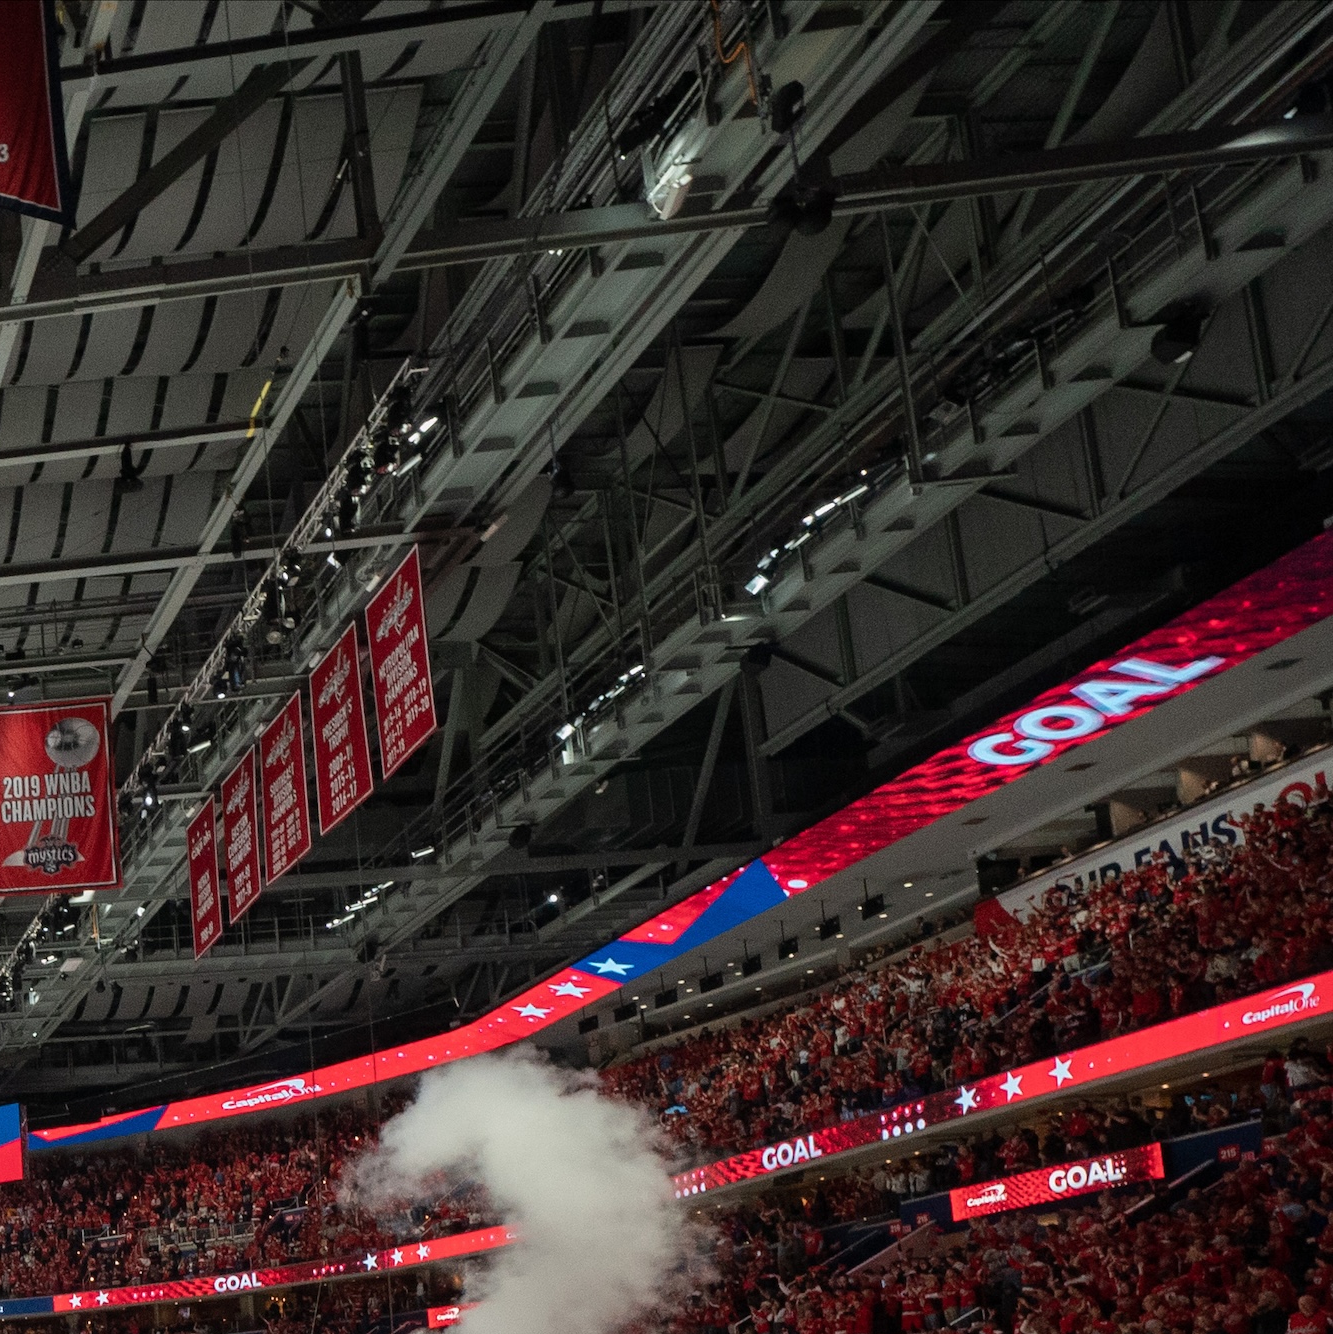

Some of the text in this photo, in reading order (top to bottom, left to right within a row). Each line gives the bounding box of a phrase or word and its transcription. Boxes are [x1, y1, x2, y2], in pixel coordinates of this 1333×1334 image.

[968, 651, 1226, 765] GOAL
[3, 771, 92, 799] 2019 WNBA
[1, 795, 96, 824] CHAMPIONS
[762, 1135, 823, 1171] GOAL
[1048, 1158, 1122, 1193] GOAL
[213, 1272, 262, 1293] GOAL
